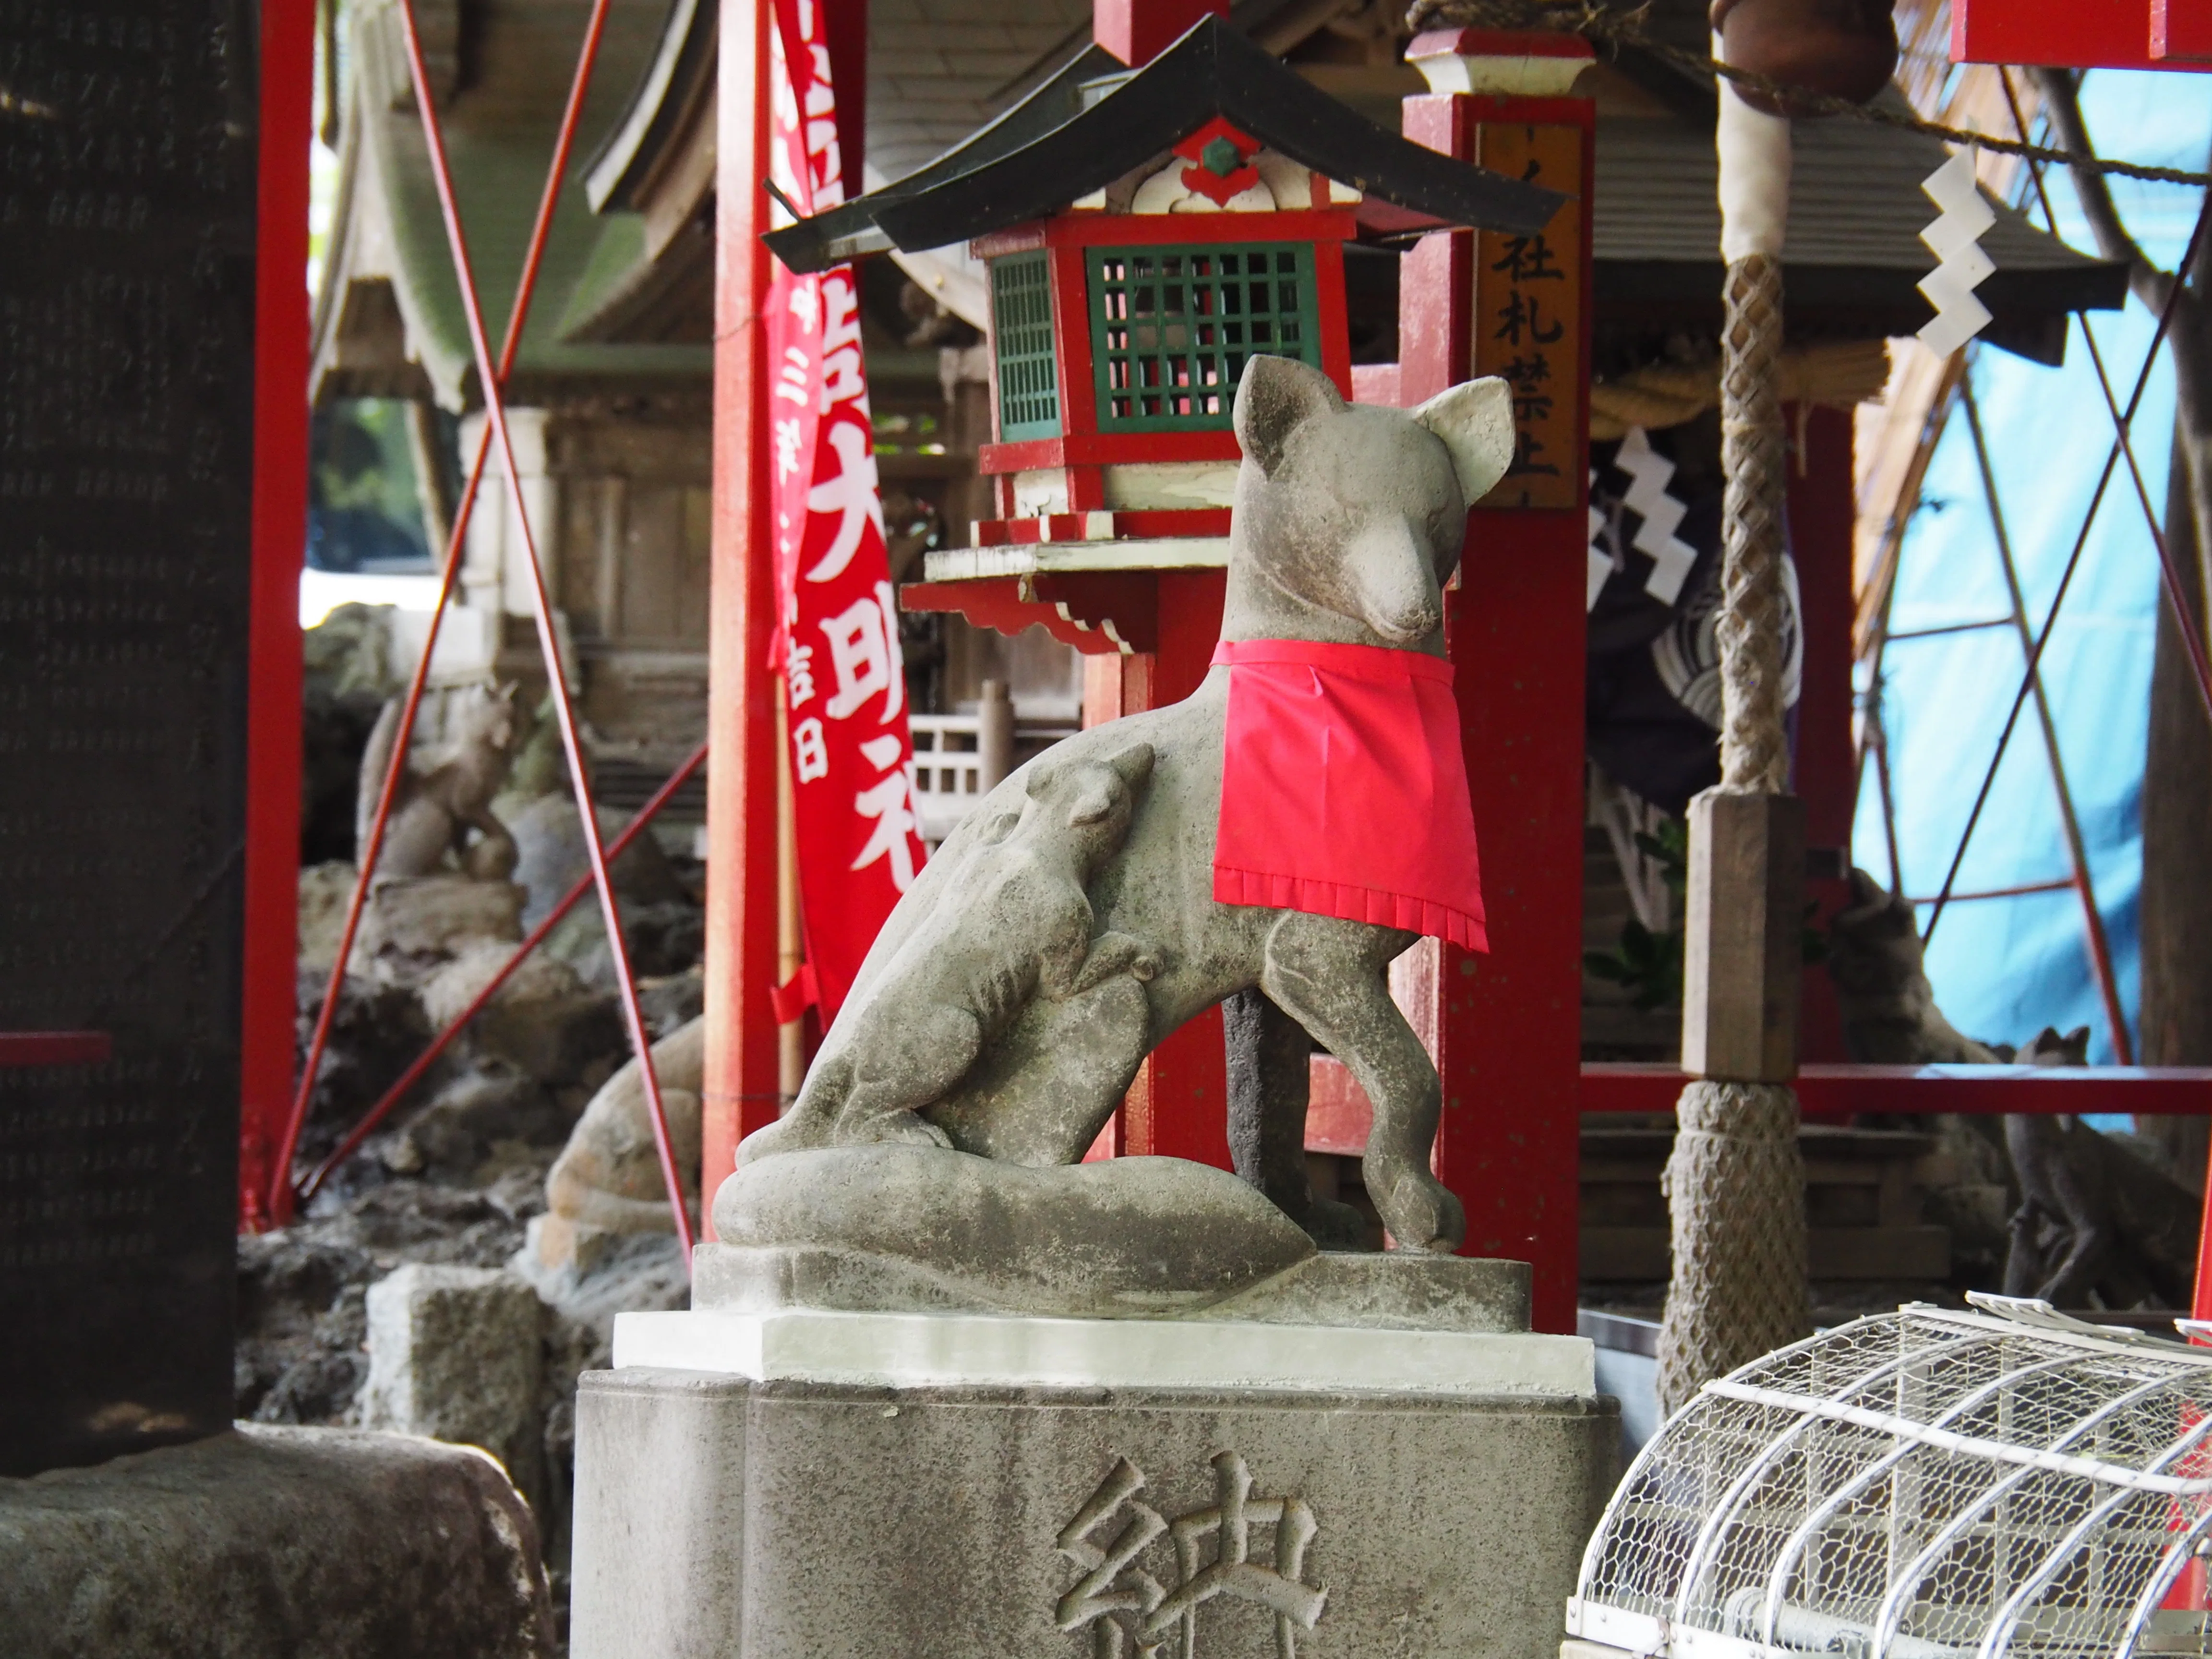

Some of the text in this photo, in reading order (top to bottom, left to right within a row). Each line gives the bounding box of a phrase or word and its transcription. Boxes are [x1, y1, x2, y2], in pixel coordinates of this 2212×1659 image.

[1492, 158, 1565, 477] 社札禁止
[788, 637, 829, 784] 吉日
